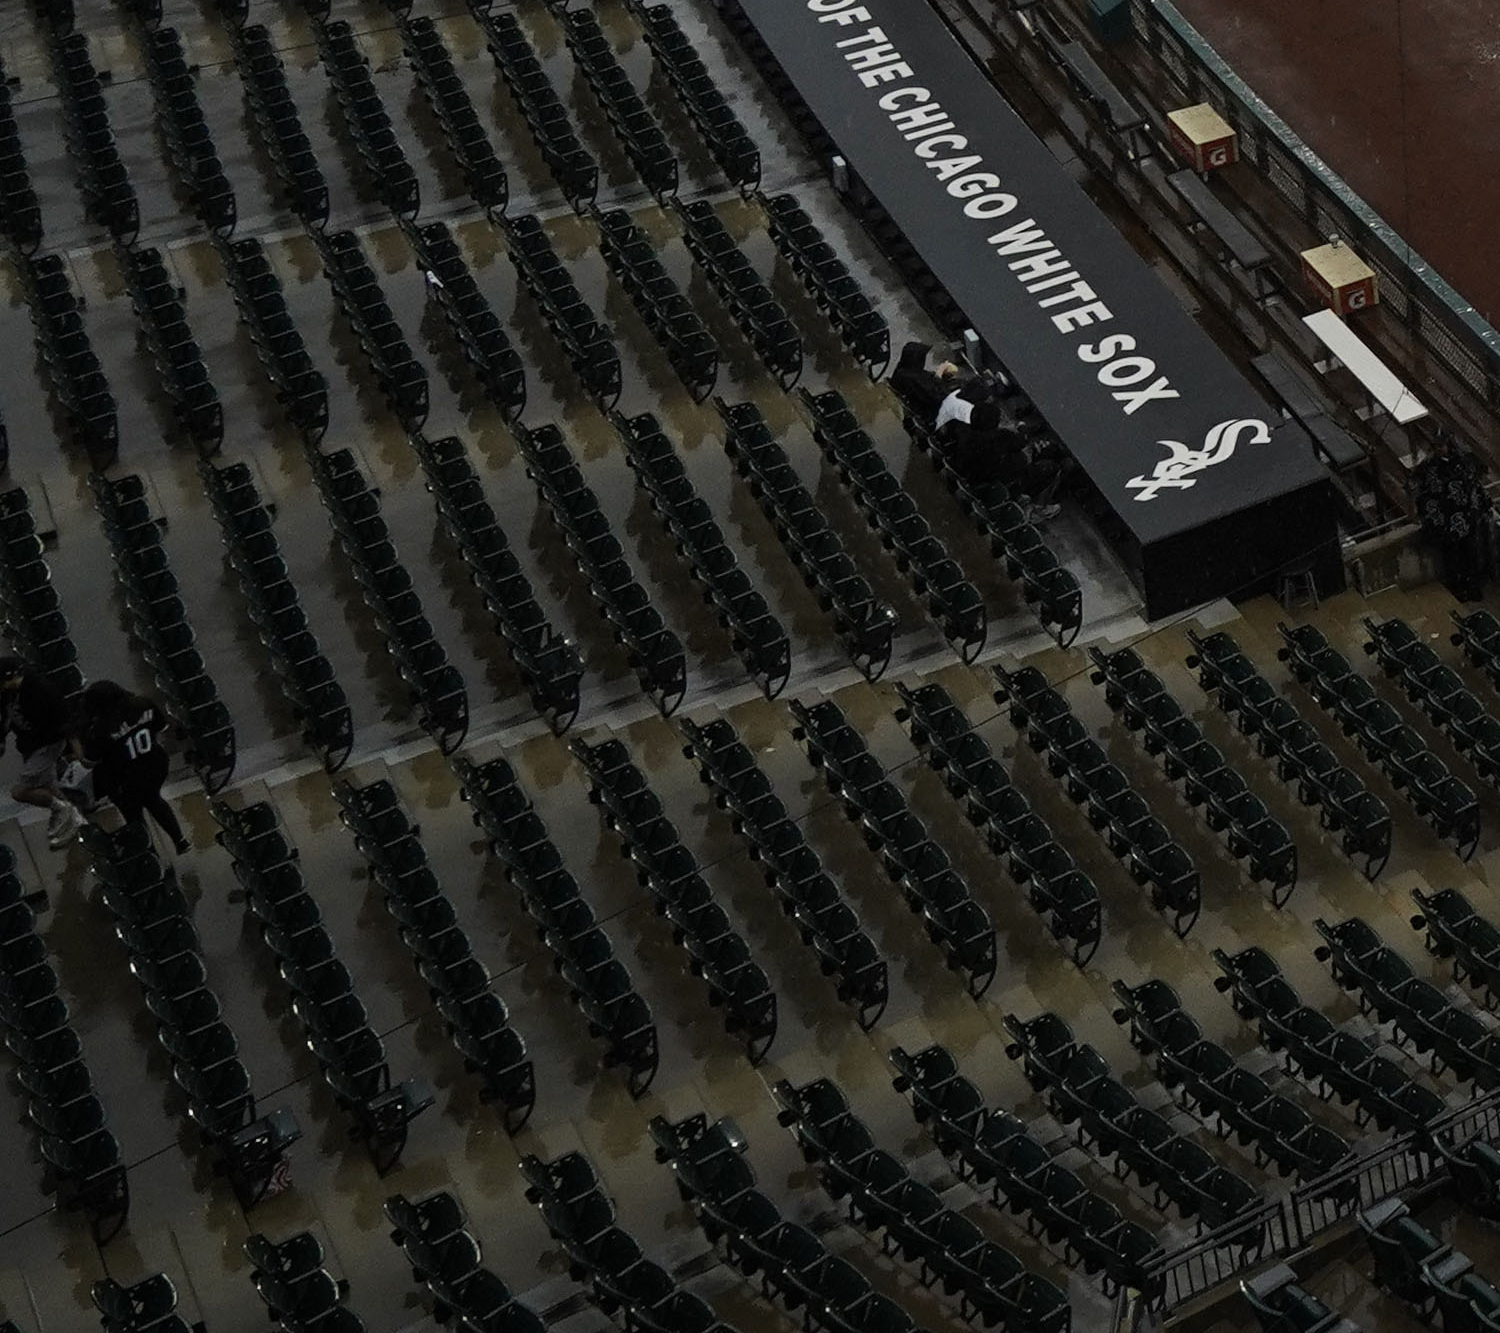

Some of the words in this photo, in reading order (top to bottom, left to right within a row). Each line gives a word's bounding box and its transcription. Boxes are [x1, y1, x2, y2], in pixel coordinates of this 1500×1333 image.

[834, 26, 914, 91] THE
[877, 85, 1019, 221] CHICAGO
[985, 217, 1115, 335] WHITE
[1077, 332, 1180, 416] SOX
[125, 727, 152, 760] 10
